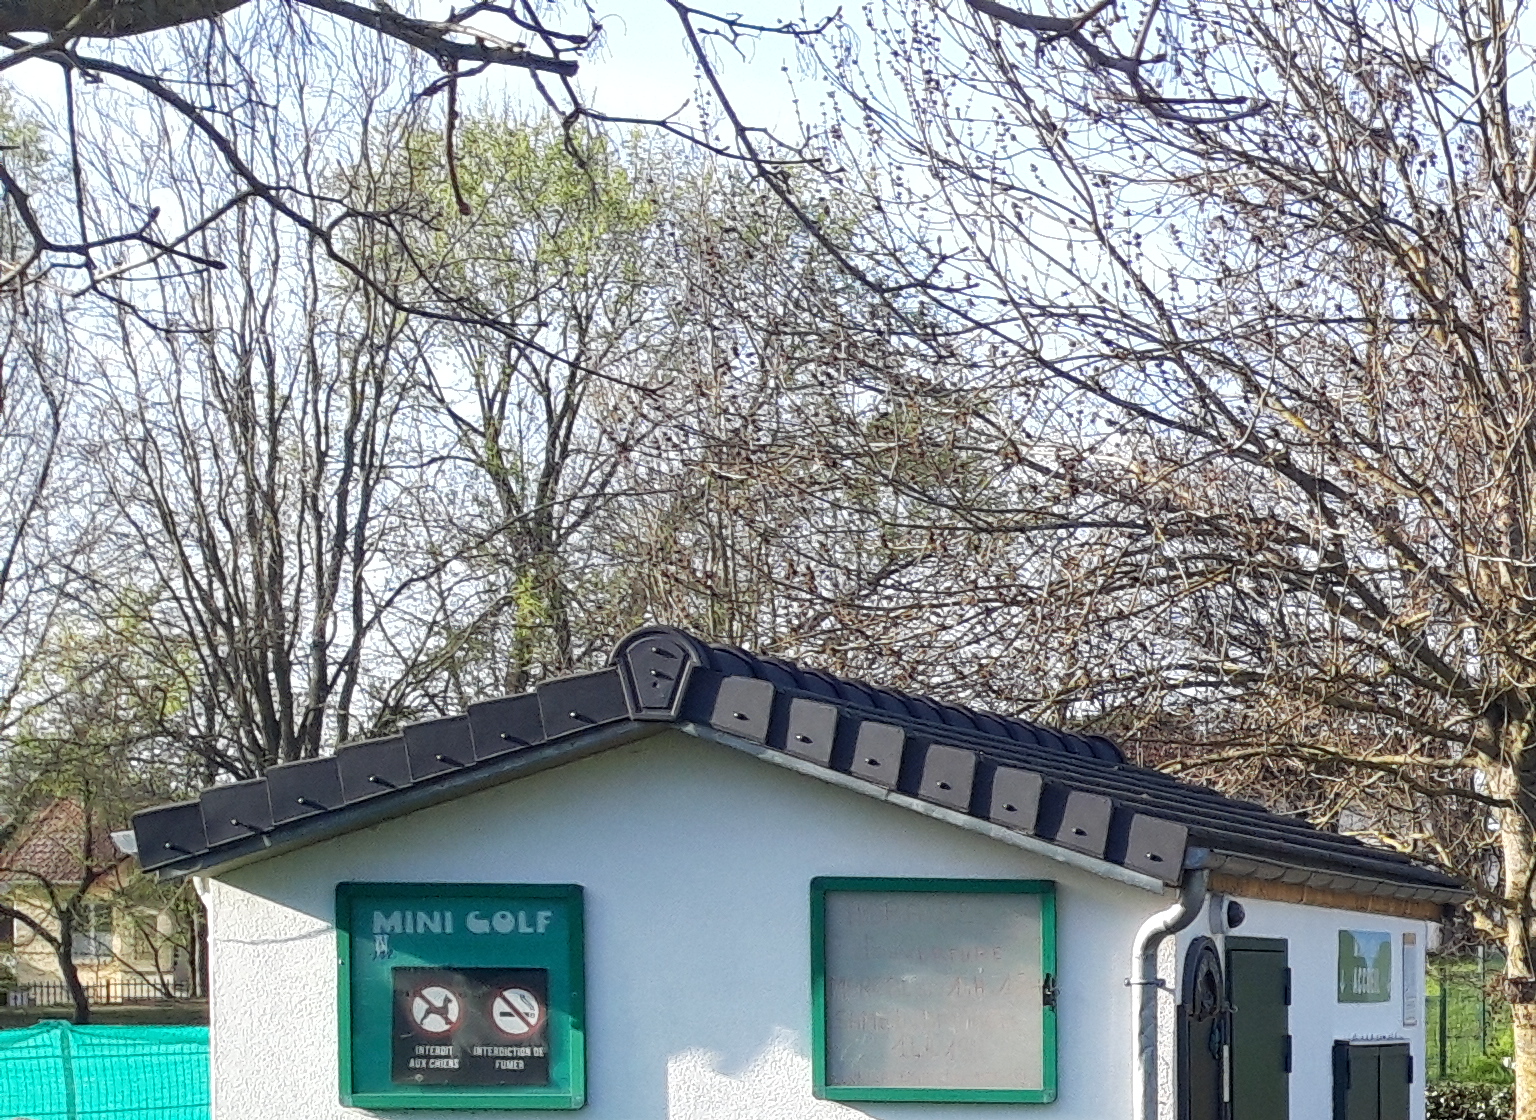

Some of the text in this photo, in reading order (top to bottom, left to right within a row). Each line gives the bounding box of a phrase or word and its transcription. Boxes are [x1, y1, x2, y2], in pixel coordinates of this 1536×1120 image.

[372, 910, 553, 934] MINI GOLF
[415, 1045, 454, 1056] INTERDIT
[473, 1046, 545, 1057] INTERDICTION DE
[409, 1058, 460, 1069] AUX CHIENS
[495, 1060, 525, 1070] FUMER
